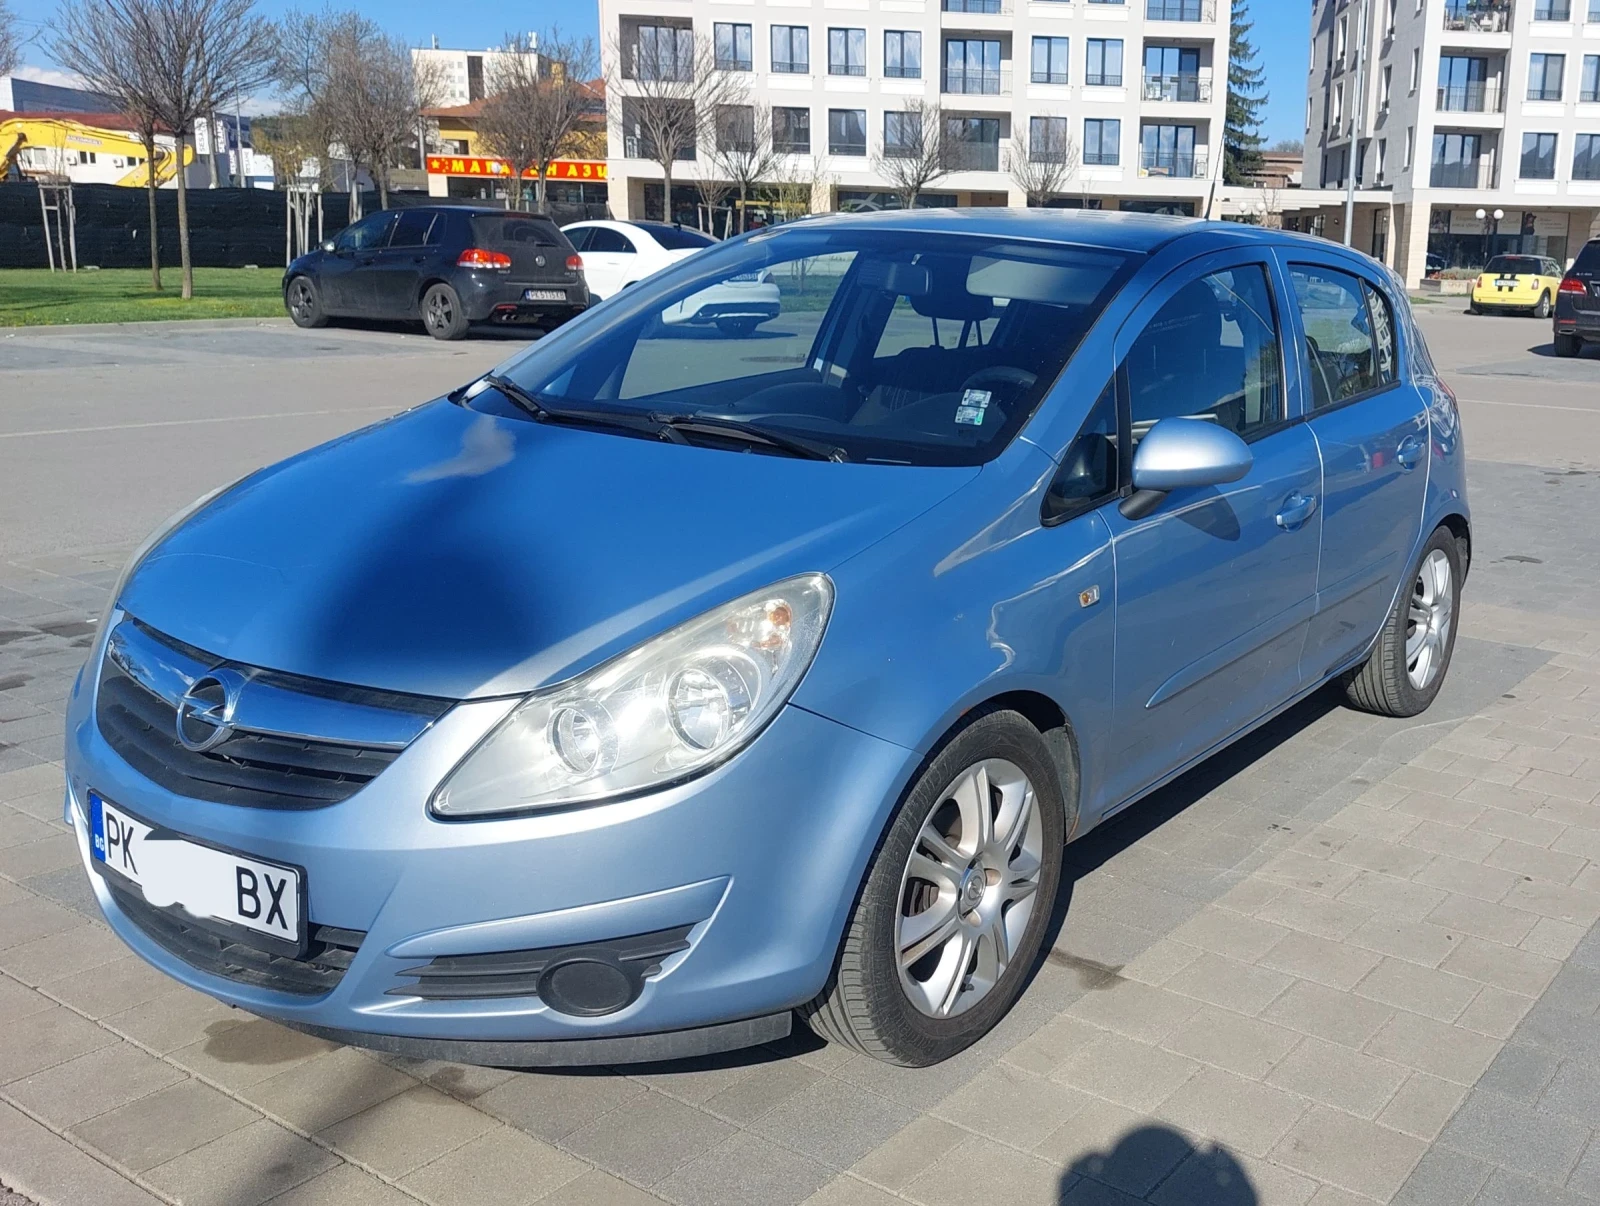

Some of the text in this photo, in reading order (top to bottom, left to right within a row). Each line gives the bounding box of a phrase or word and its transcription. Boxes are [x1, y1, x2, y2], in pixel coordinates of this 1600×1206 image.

[451, 159, 557, 176] МАГАН
[95, 833, 105, 851] BG
[105, 811, 288, 931] PK BX
